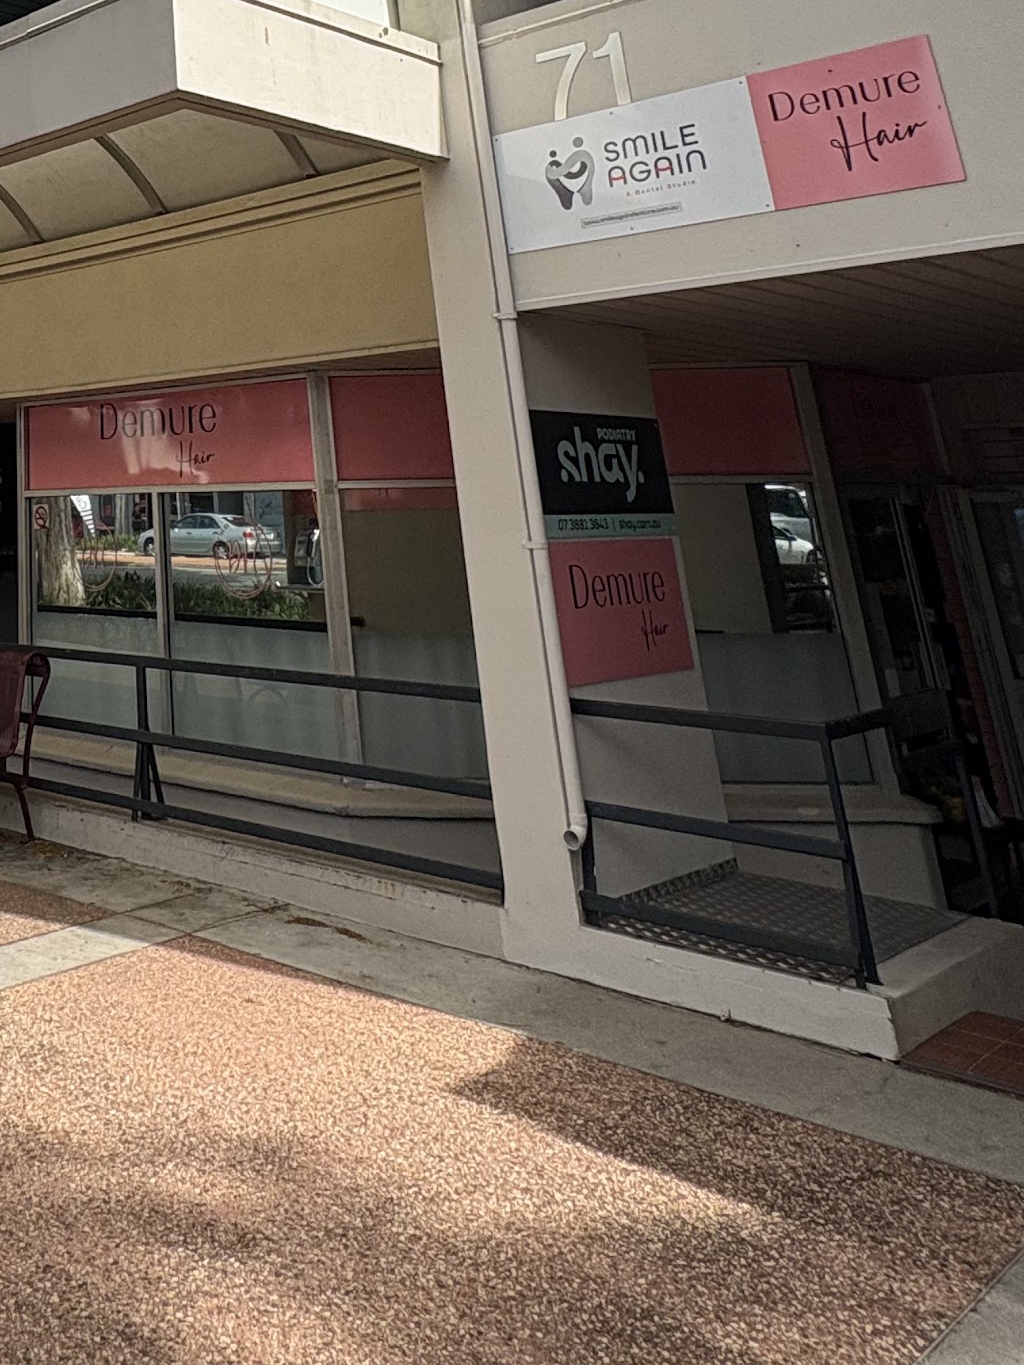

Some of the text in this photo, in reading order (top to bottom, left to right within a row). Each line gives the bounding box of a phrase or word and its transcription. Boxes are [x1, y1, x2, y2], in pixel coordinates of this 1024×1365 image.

[535, 31, 632, 122] 71
[768, 68, 921, 123] Demure
[603, 123, 699, 162] SMILE
[830, 111, 927, 172] Hair
[607, 149, 707, 187] AGAIN
[99, 402, 217, 441] Demure
[596, 428, 636, 441] PODIATRY
[175, 441, 216, 478] Hair
[557, 518, 568, 530] 07
[568, 564, 666, 610] Demure
[640, 609, 669, 652] Hair
